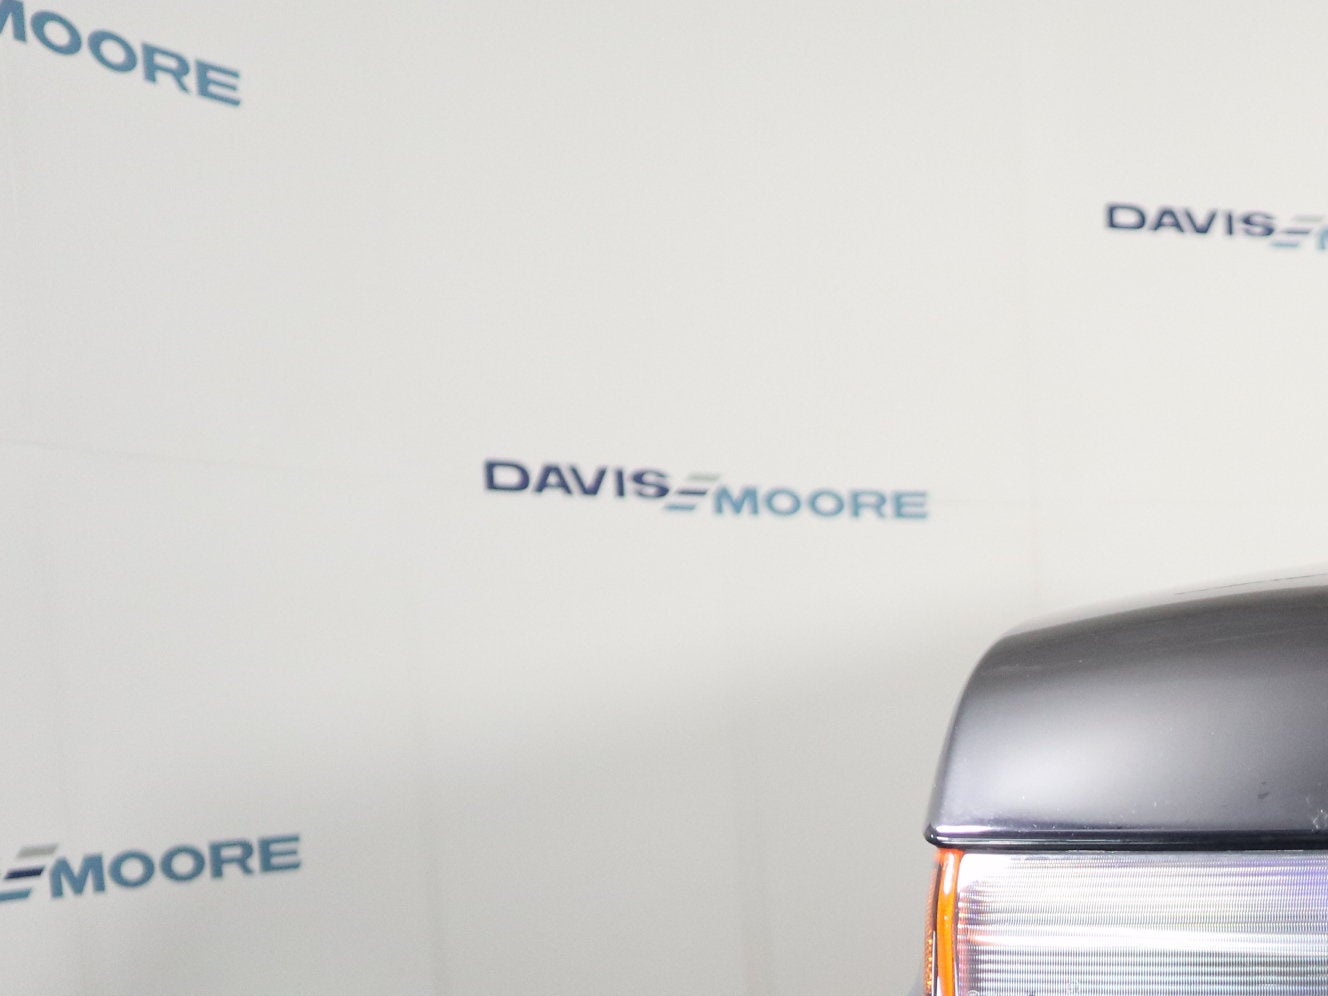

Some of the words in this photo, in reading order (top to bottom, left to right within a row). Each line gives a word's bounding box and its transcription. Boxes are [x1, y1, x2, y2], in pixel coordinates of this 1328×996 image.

[1105, 202, 1276, 237] DAVIS
[484, 460, 672, 498] DAVIS
[711, 487, 929, 519] MOORE
[50, 834, 300, 898] MOORE
